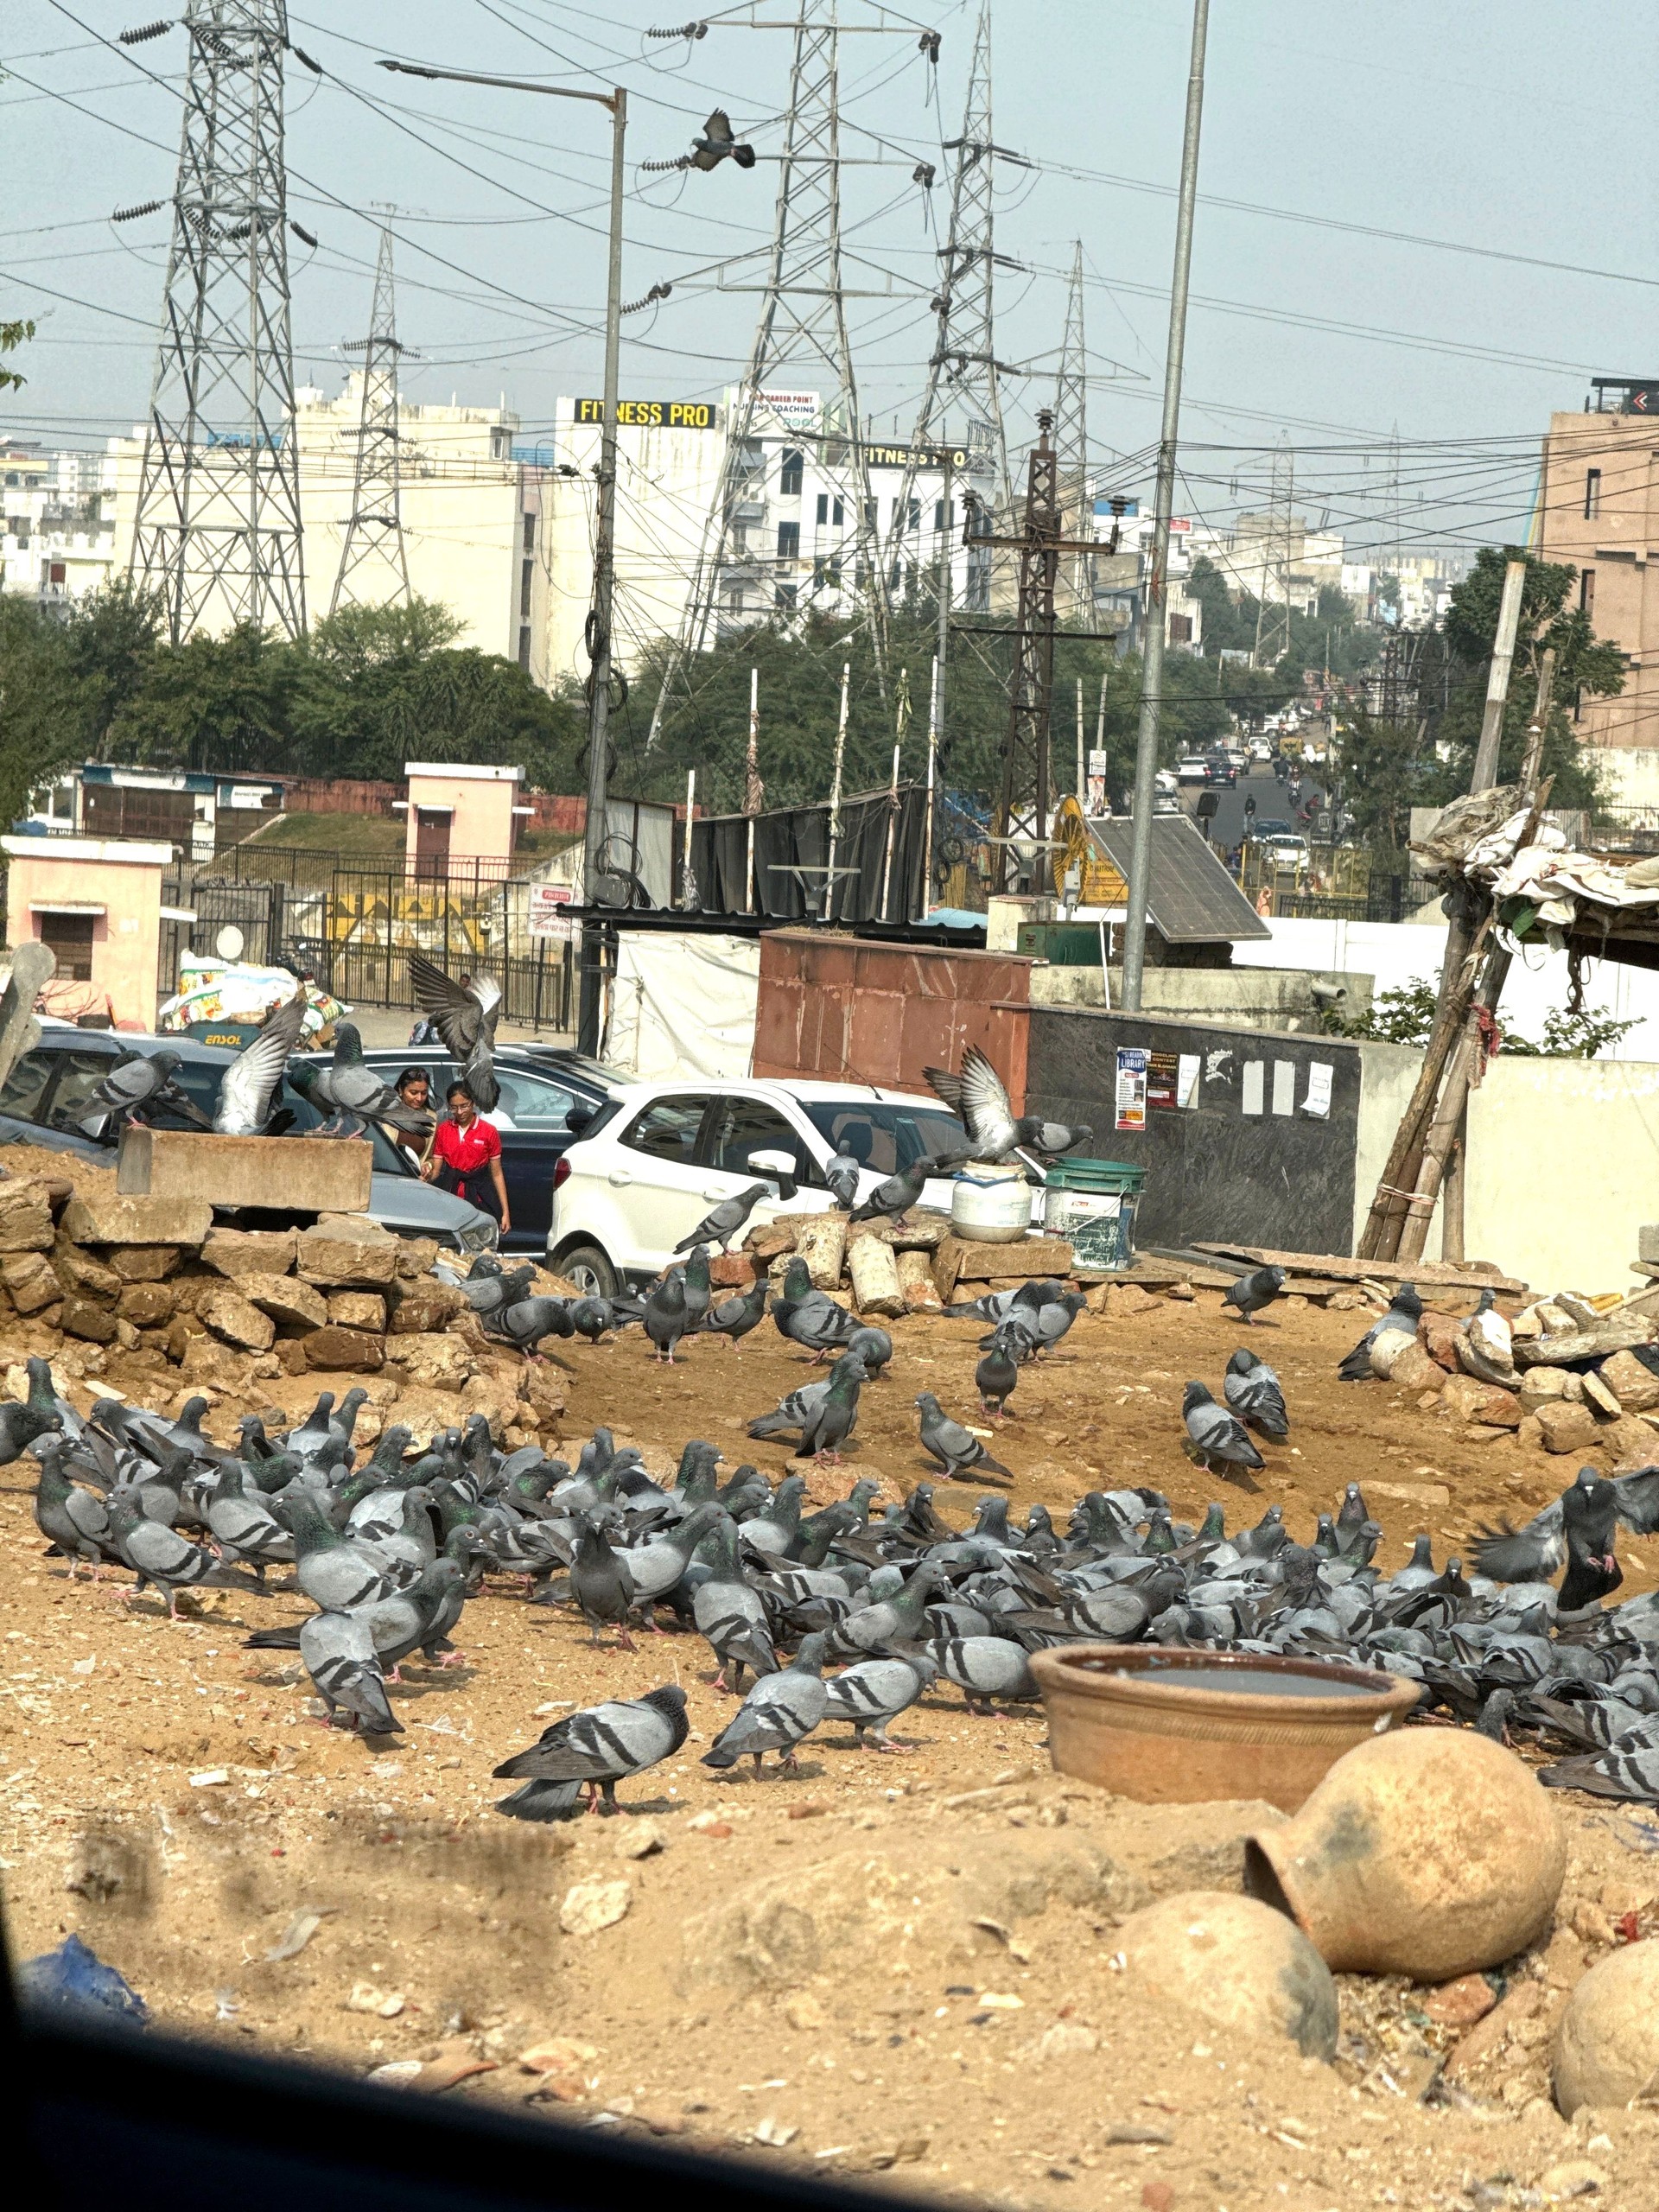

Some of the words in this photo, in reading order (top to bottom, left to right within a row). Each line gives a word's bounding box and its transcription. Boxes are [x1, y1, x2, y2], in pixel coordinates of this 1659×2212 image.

[792, 395, 814, 404] POINT
[581, 399, 662, 425] FINESS
[670, 404, 709, 427] PRO
[863, 446, 928, 466] FITNES
[932, 451, 966, 467] PO
[1121, 1058, 1146, 1070] LIBRARY
